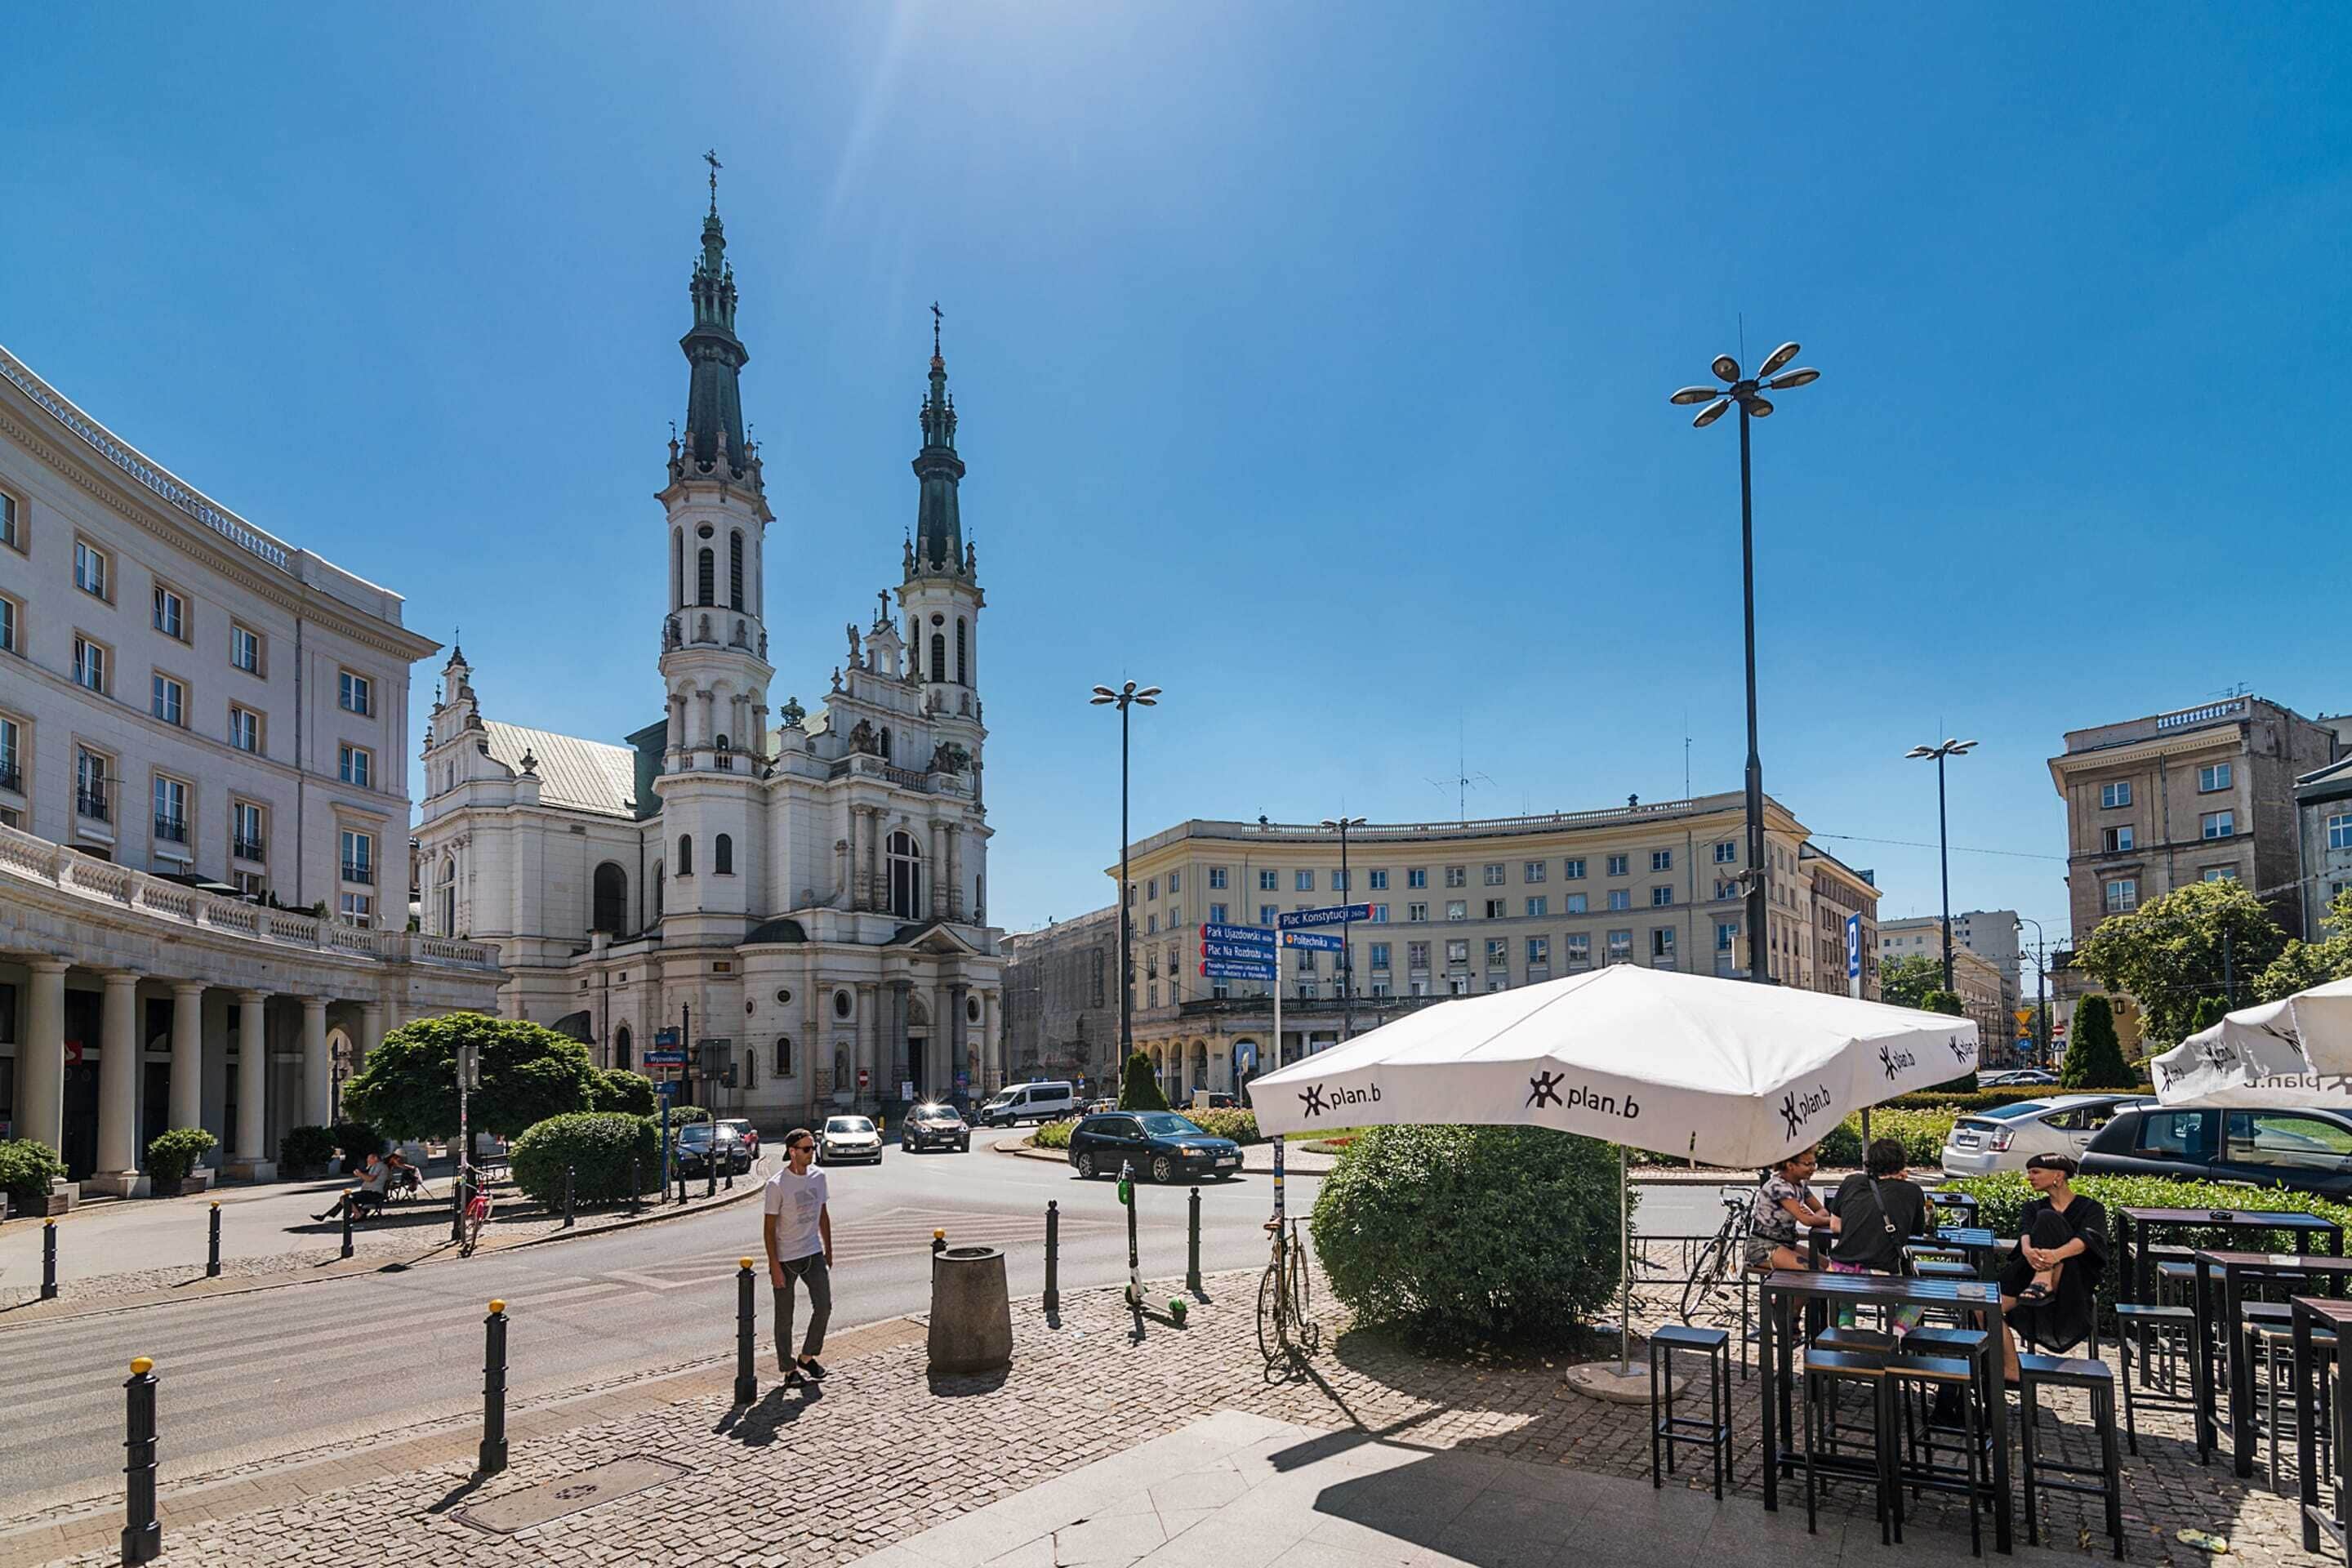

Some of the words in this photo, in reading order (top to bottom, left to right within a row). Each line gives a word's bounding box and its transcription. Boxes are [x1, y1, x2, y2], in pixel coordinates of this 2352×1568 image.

[1283, 915, 1299, 925] Plac
[1303, 907, 1348, 923] Konstytucji
[1207, 926, 1222, 938] Park
[1224, 927, 1261, 941] Ujazdowski
[1294, 934, 1328, 947] Politechnika
[1208, 944, 1222, 956] Plac
[1223, 945, 1232, 956] Na
[1892, 1049, 1916, 1073] plan.b
[1330, 1082, 1382, 1111] plan.b
[1567, 1085, 1640, 1120] plan.b
[1799, 1085, 1831, 1125] plan.b
